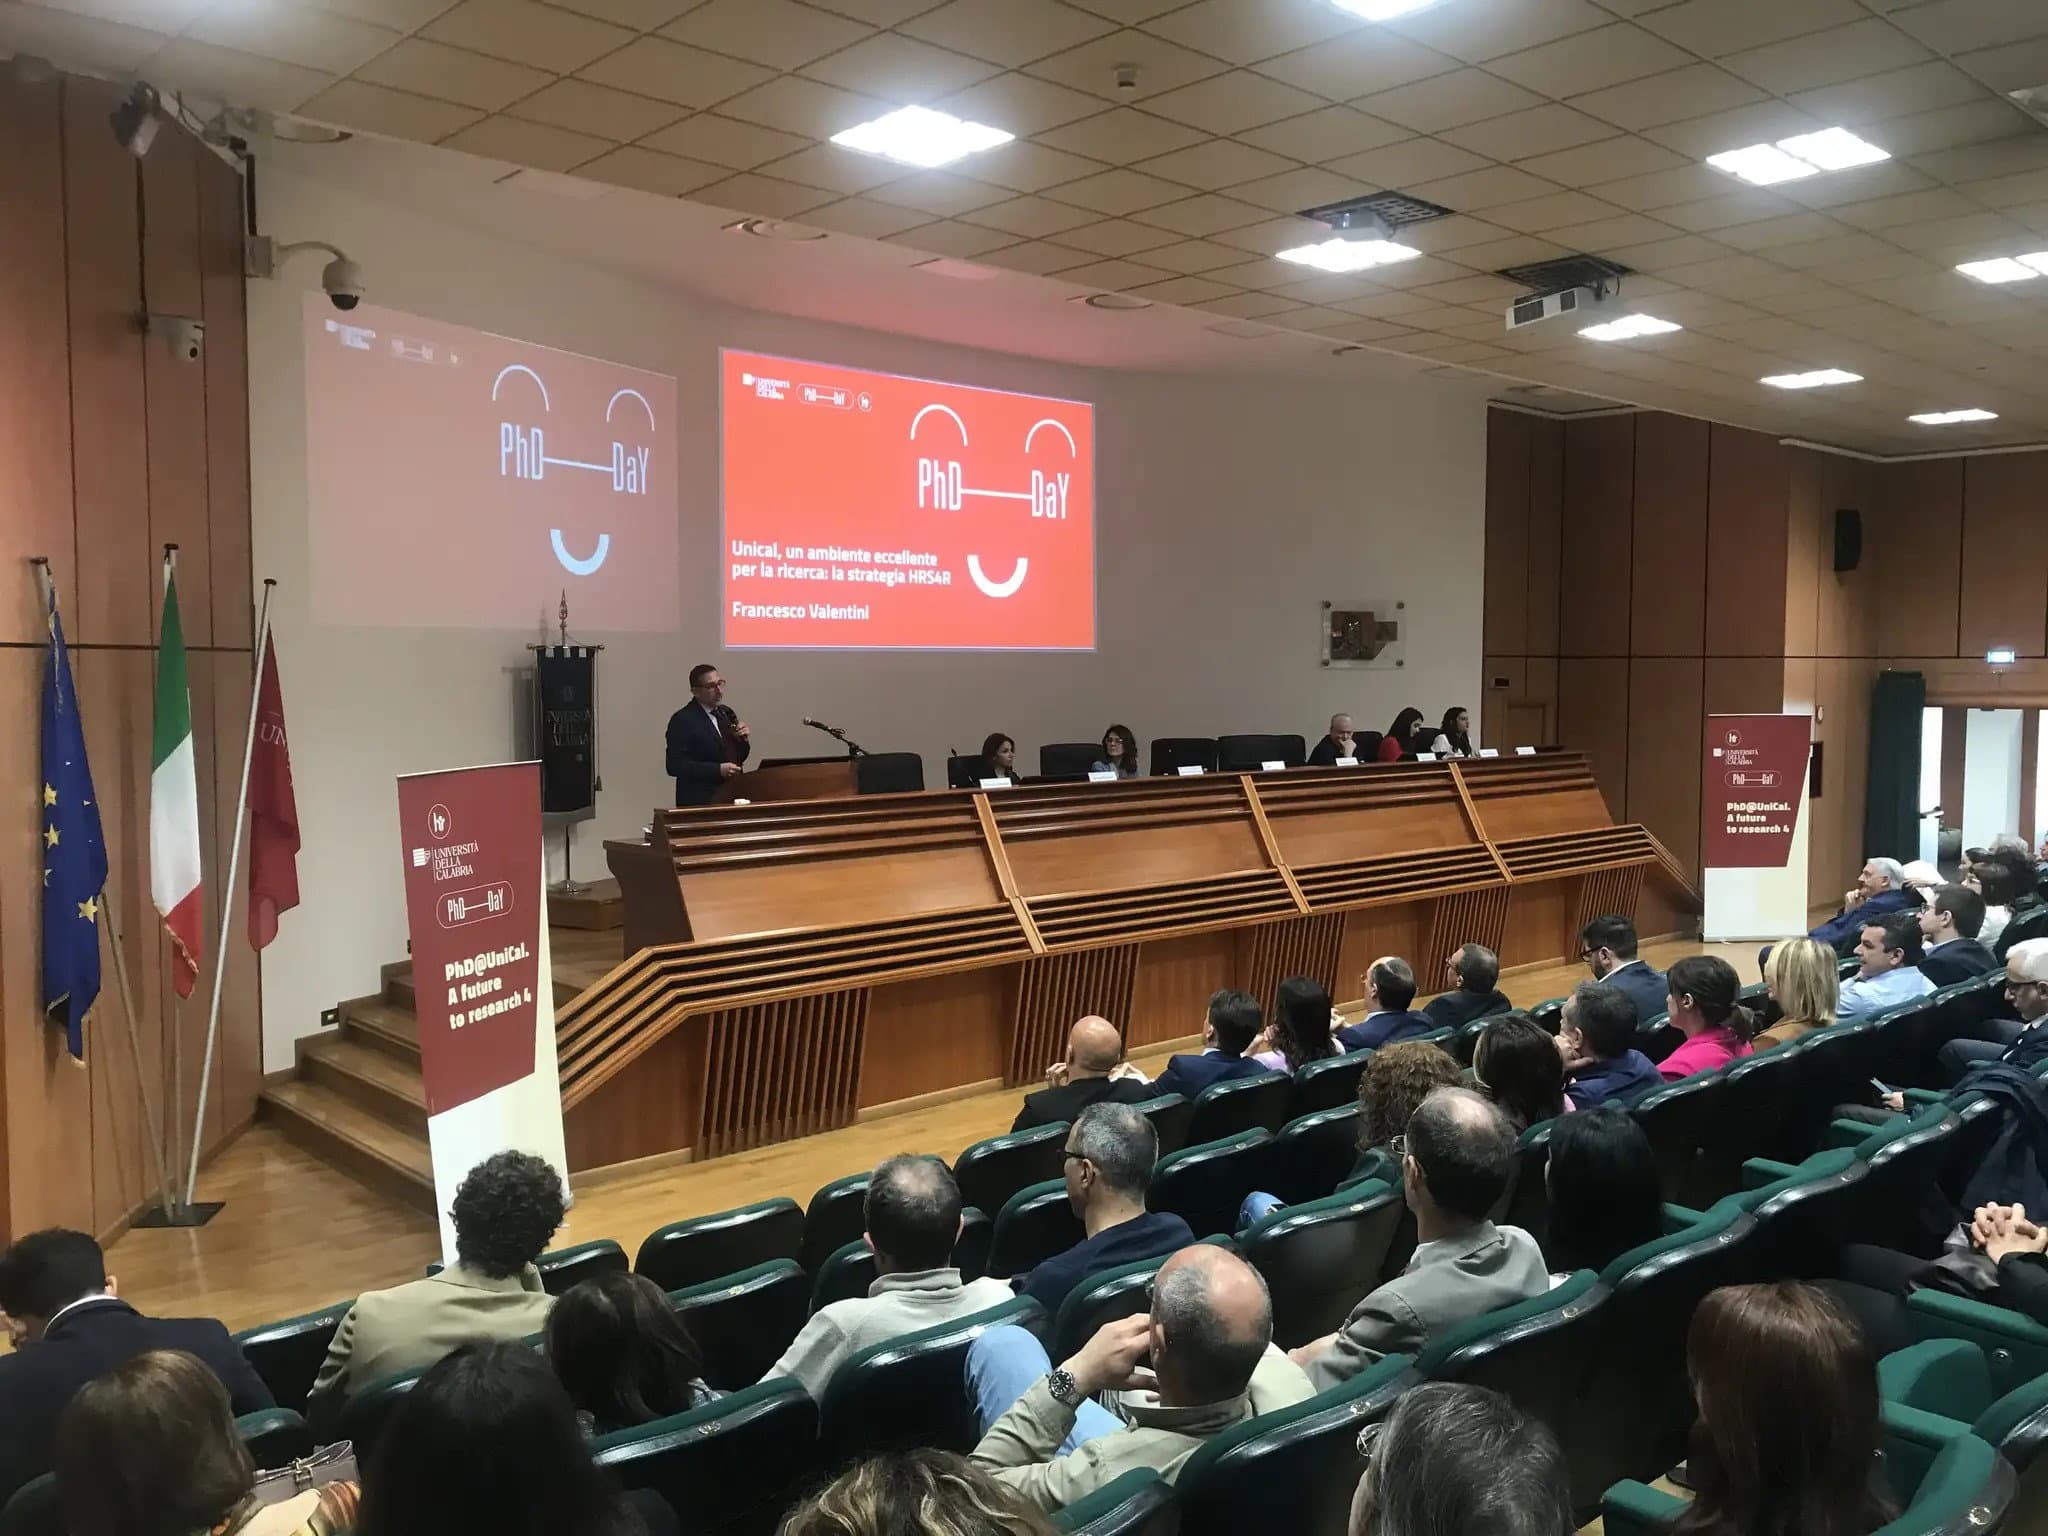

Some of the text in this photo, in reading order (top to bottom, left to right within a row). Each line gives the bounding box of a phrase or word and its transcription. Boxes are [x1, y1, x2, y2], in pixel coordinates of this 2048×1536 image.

[501, 422, 649, 495] PhD DaY
[919, 457, 1070, 519] PhD DaY
[731, 540, 938, 566] Unical, un ambiente eccellente
[732, 562, 951, 587] per la ricerca: la strategia HRS4R
[732, 601, 869, 619] Francesco Valentini
[1732, 774, 1745, 785] PhD
[1726, 802, 1791, 813] PhD@UniCal.
[1726, 814, 1767, 822] A future
[1726, 825, 1737, 833] to
[1739, 824, 1780, 833] research
[434, 840, 479, 860] UNIVERSITÀ
[435, 856, 461, 870] DELLA
[436, 864, 474, 881] CALABRIA
[447, 888, 504, 922] PhD DaY
[445, 942, 530, 981] PhD@UniCal.
[448, 977, 502, 1006] A future
[449, 1013, 465, 1029] to
[468, 990, 522, 1024] research
